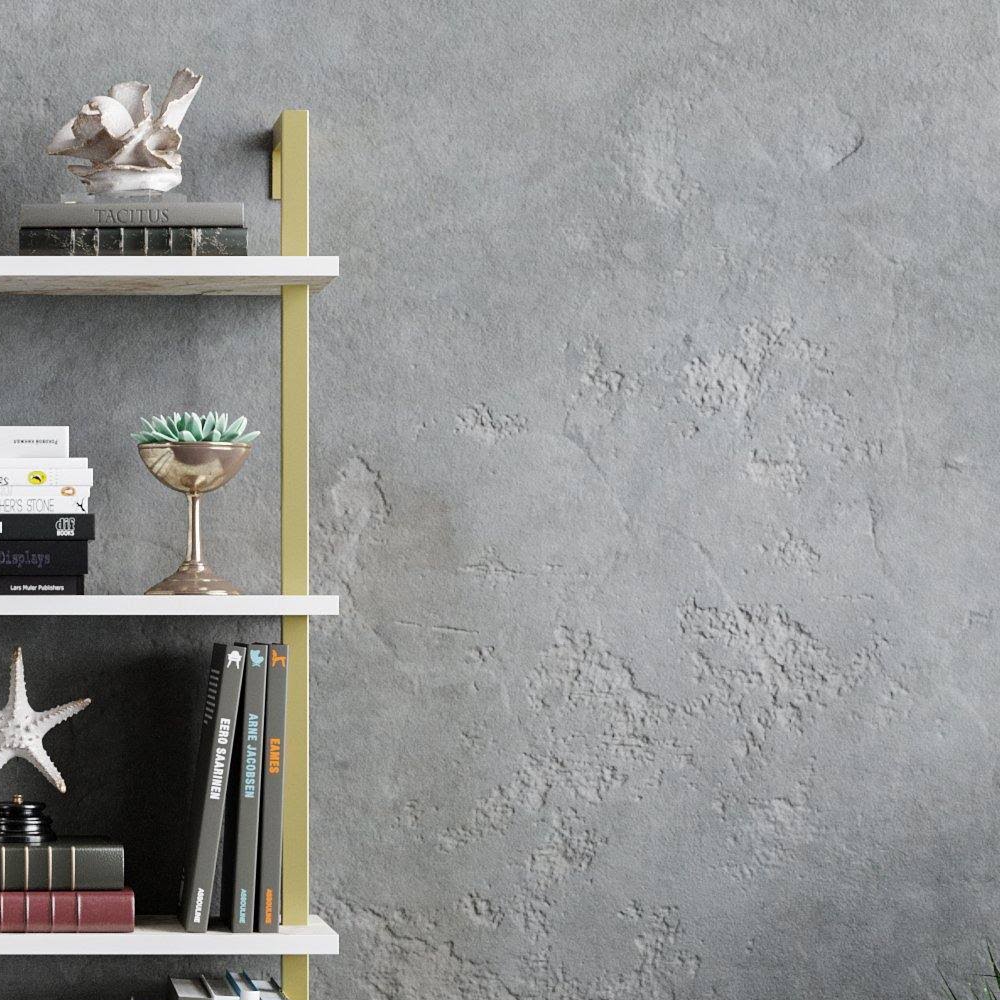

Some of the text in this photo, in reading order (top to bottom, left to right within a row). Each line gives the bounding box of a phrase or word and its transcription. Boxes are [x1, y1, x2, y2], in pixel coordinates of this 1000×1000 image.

[94, 208, 169, 224] TACITUS
[26, 499, 54, 512] STONE
[55, 517, 76, 530] dif
[0, 551, 51, 568] Displays
[210, 718, 231, 800] EERO SAARINEN
[244, 713, 259, 798] ARNE JACOBSEN
[268, 738, 281, 774] EAMES
[194, 887, 205, 923] ASSOULINE
[239, 888, 248, 924] ASSOULINE
